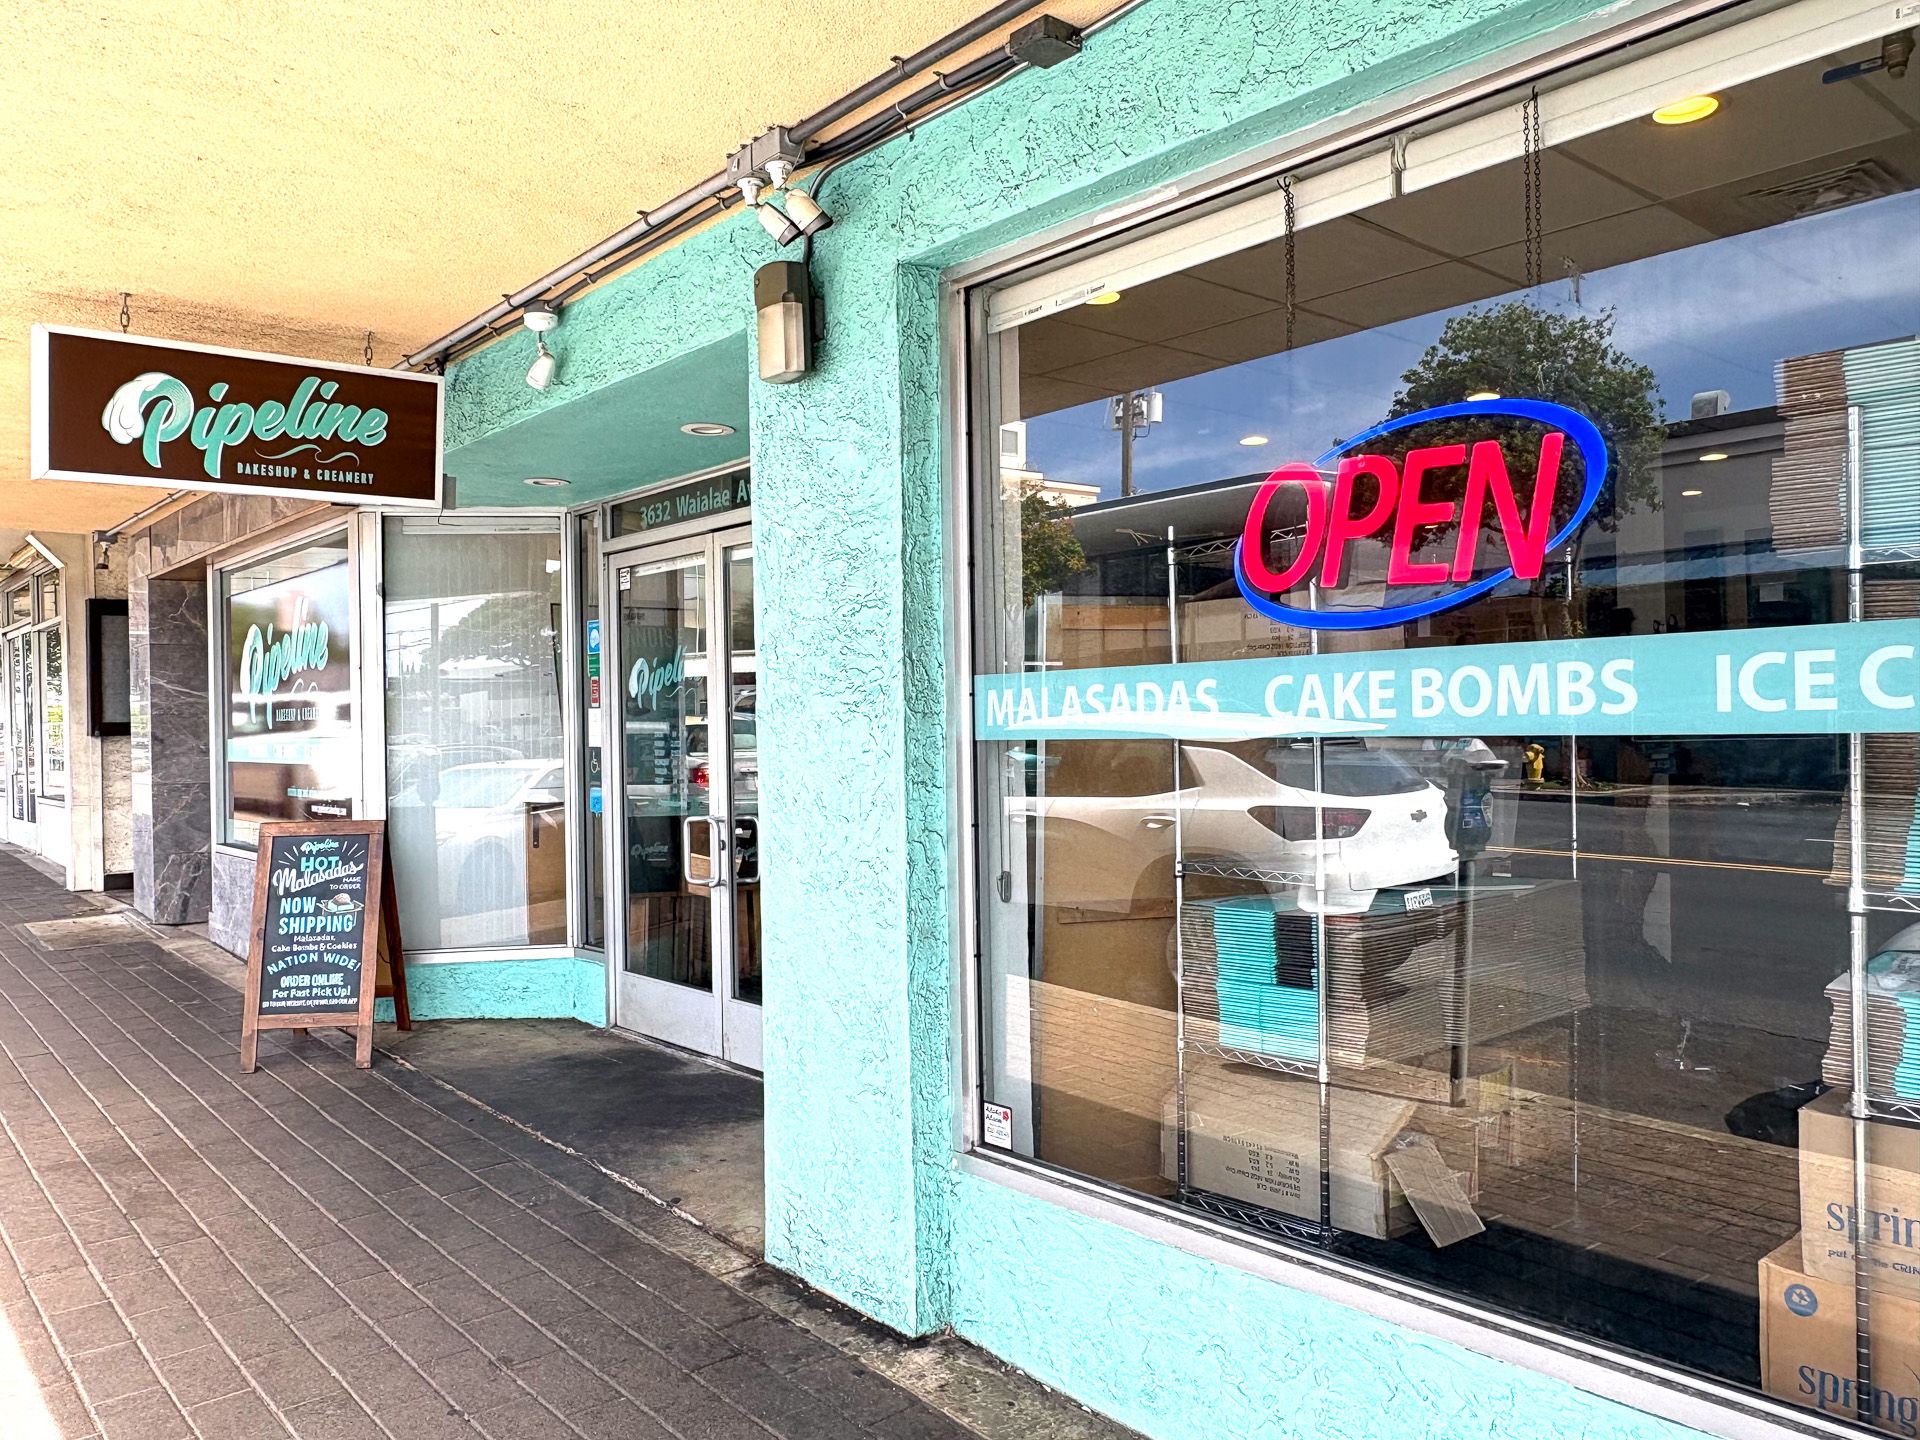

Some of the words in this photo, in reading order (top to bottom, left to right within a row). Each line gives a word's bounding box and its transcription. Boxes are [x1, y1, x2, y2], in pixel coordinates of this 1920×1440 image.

[101, 372, 389, 479] Pipeline
[237, 462, 298, 479] BAKESHOP
[303, 469, 311, 480] &
[316, 469, 375, 485] CREAMERY
[640, 500, 671, 530] 3632
[676, 487, 730, 518] Waialae
[1242, 432, 1565, 593] OPEN
[239, 596, 329, 730] Pipeline
[629, 645, 703, 711] Pipeli
[986, 678, 1219, 727] MALASADAS
[1264, 670, 1397, 720] CAKE
[1411, 658, 1639, 719] BOMBS
[1715, 649, 1838, 712] ICE
[1859, 644, 1916, 710] C
[300, 856, 340, 872] HOT
[272, 860, 365, 896] Malasadas
[280, 896, 317, 915] NOW
[278, 914, 354, 936] SHIPPING
[271, 944, 291, 953] Cake
[292, 943, 319, 952] Bombs
[319, 943, 326, 951] &
[326, 941, 358, 950] Cookies
[266, 952, 319, 975] NATION
[323, 952, 362, 972] WIDE!
[272, 989, 290, 999] For
[289, 988, 310, 998] Fast
[311, 987, 333, 997] Pick
[333, 985, 351, 998] Up!
[280, 974, 311, 988] ORDER
[311, 973, 345, 986] ONLINE
[1828, 1249, 1847, 1258] put
[1798, 1365, 1919, 1438] sprng
